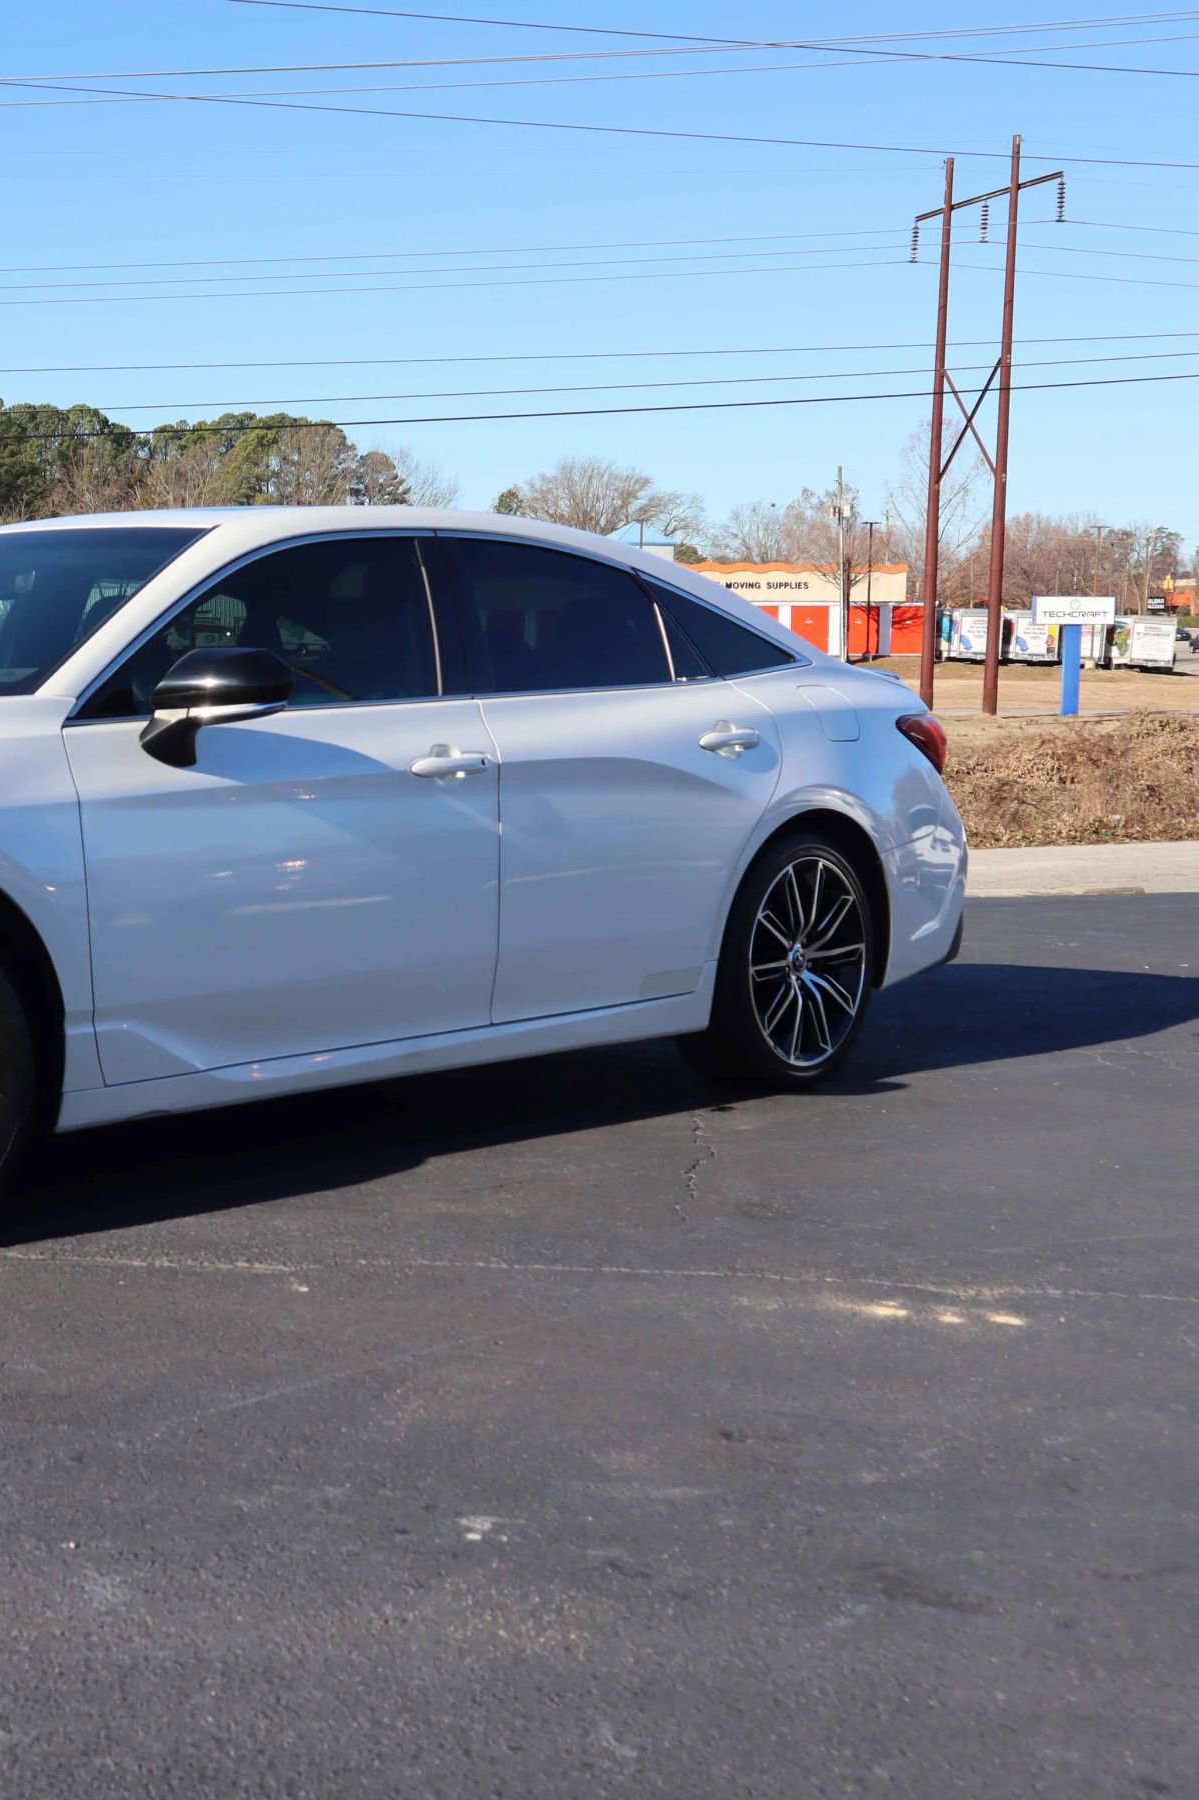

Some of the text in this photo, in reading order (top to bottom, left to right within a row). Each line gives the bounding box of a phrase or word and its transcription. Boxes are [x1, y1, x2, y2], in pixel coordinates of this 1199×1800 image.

[725, 581, 809, 590] MOVING SUPPLIES
[1041, 610, 1109, 618] TECHCRAFT
